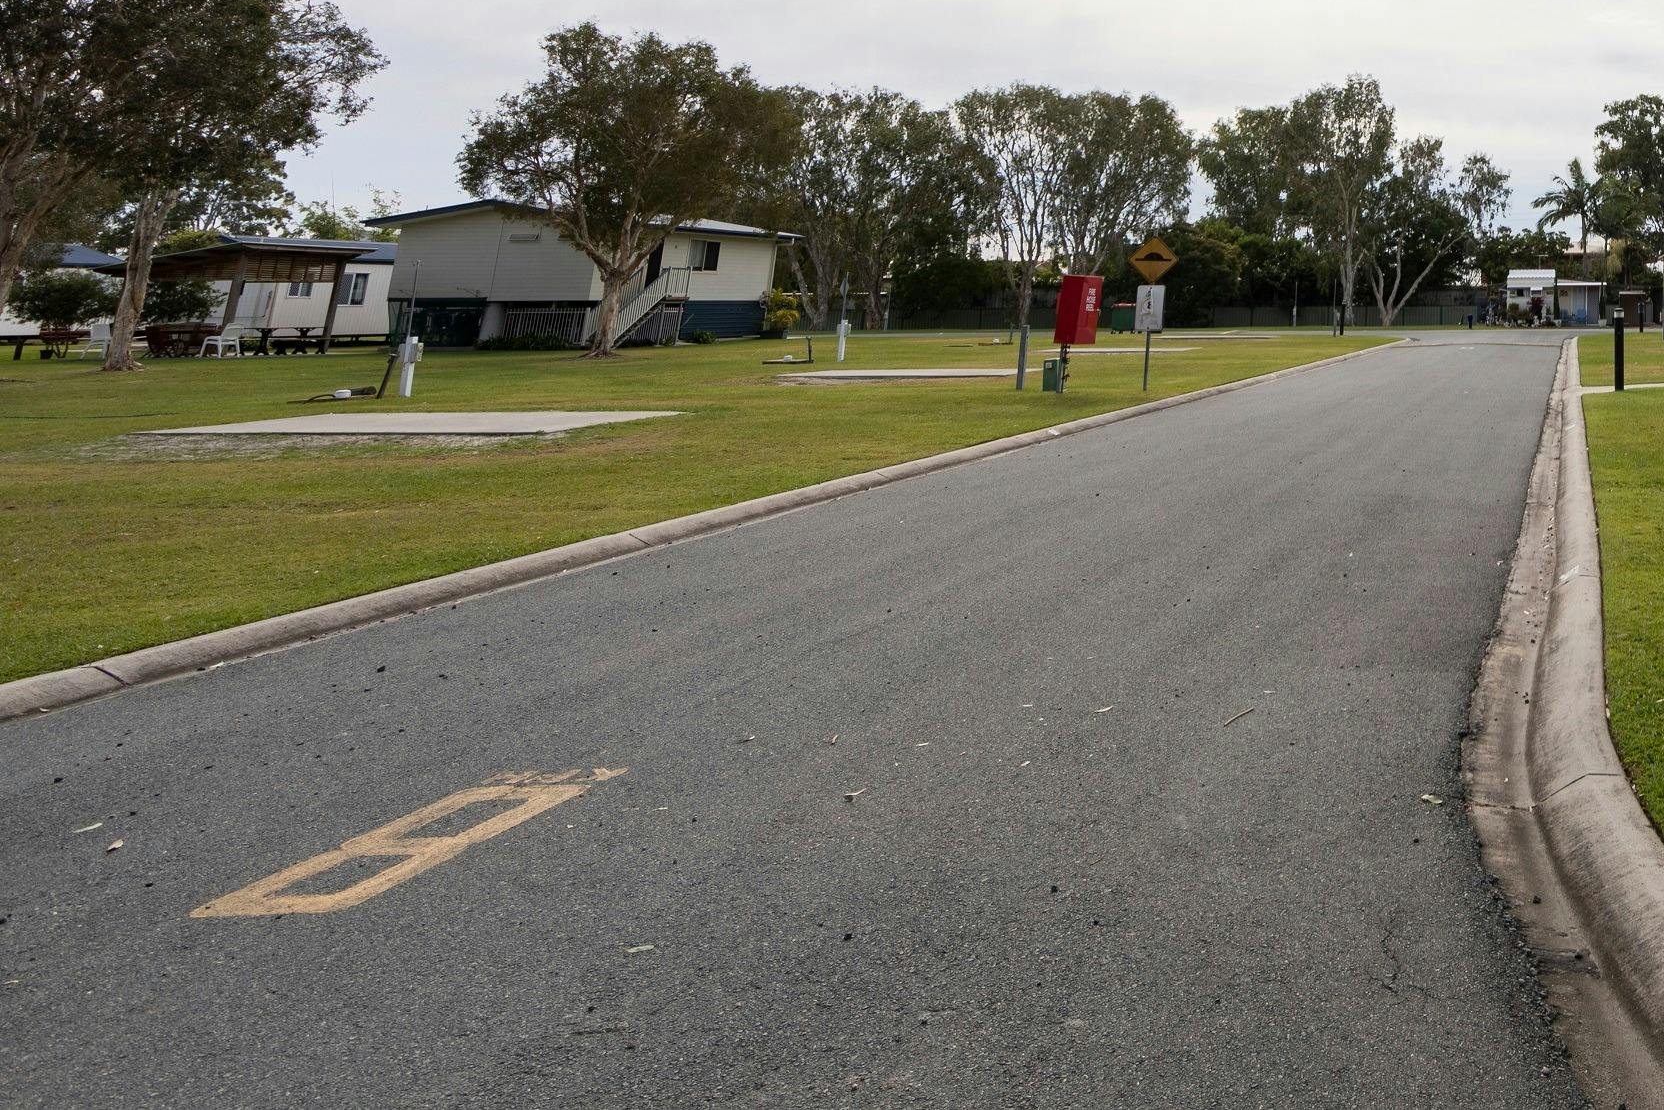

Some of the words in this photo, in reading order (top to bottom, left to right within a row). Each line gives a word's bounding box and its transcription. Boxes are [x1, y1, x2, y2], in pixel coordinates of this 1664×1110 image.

[1088, 288, 1096, 296] FIRE
[1086, 296, 1096, 304] HOSE
[189, 782, 592, 918] 8
